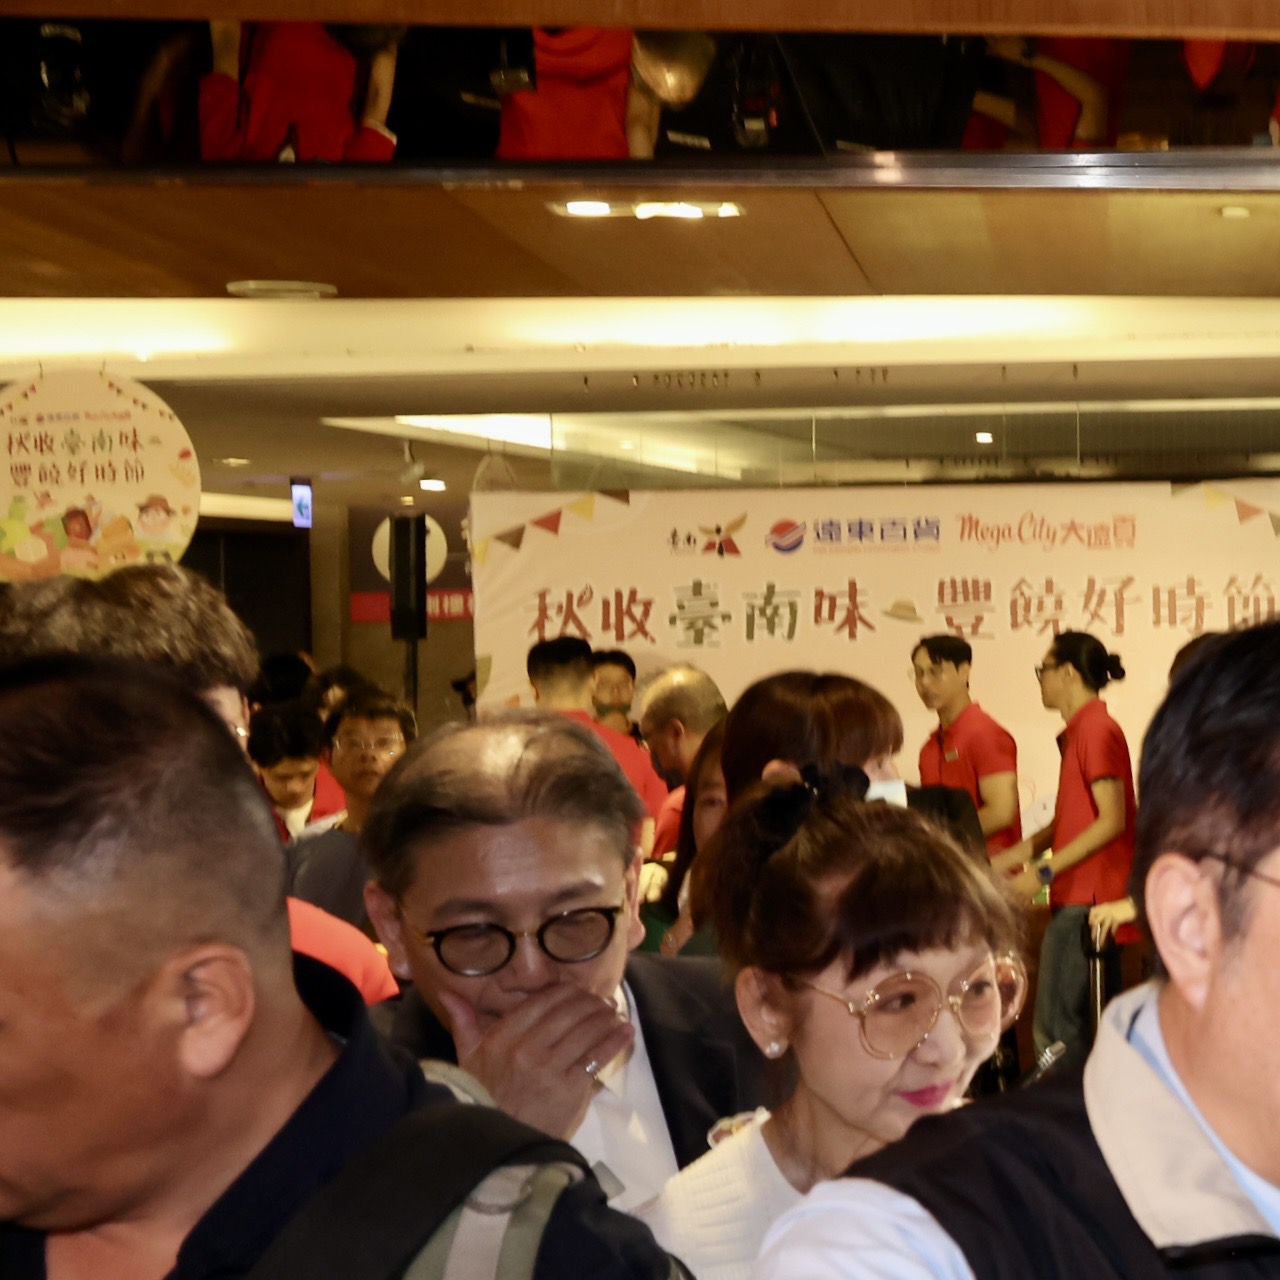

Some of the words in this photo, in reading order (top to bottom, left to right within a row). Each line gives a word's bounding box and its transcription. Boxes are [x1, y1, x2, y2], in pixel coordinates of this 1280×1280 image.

[955, 512, 1014, 553] Mega
[1017, 509, 1057, 553] City
[523, 577, 876, 648] 秋收臺南味
